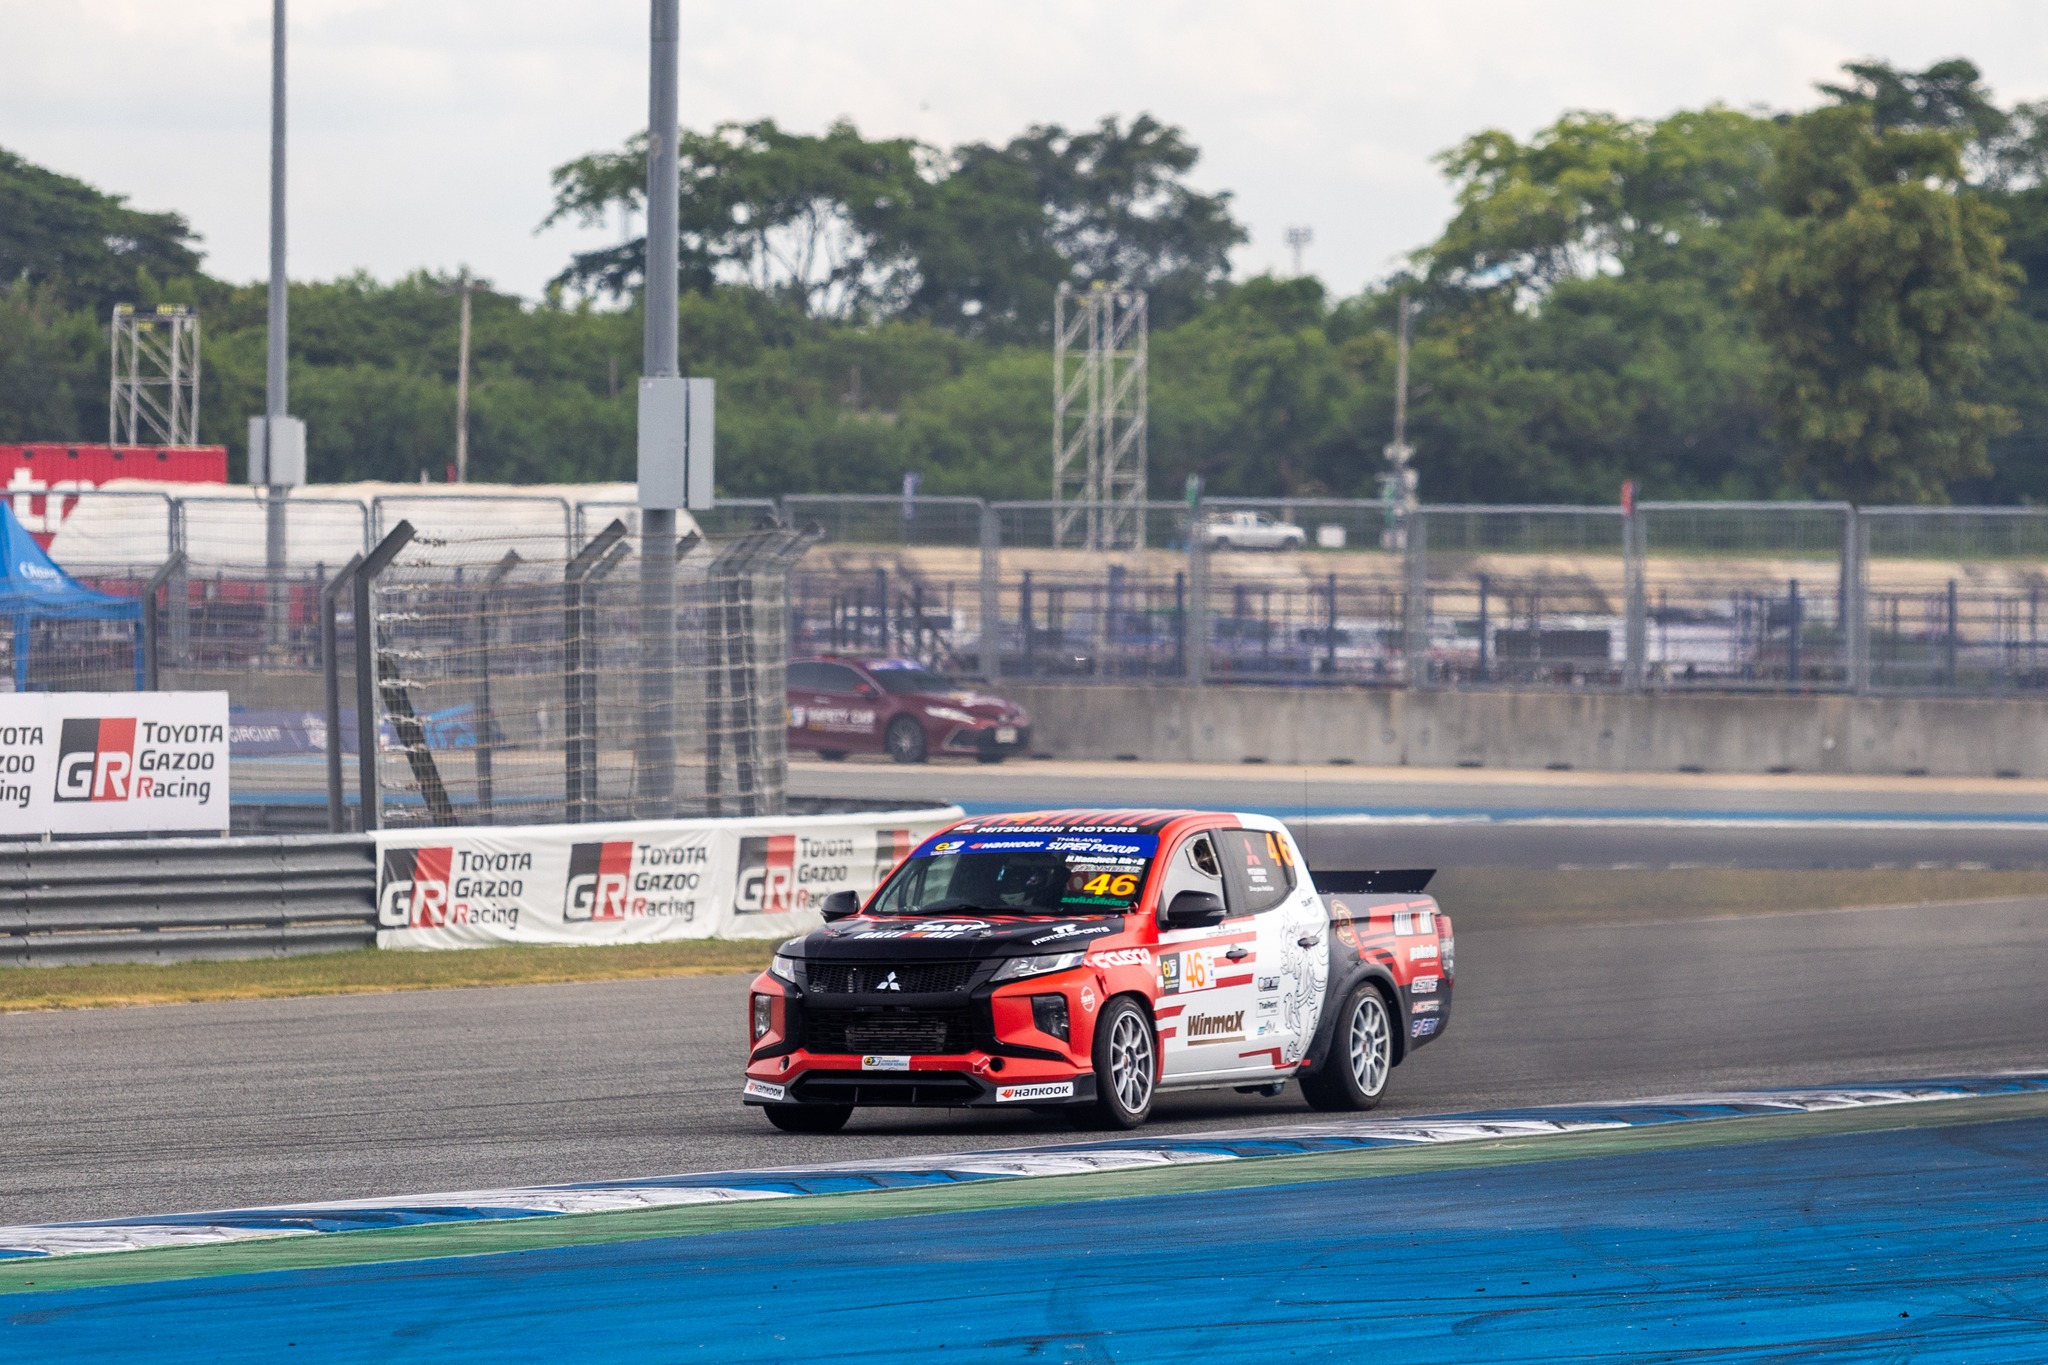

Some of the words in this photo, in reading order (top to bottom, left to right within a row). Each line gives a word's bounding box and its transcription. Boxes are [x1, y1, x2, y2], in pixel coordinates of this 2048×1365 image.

[143, 722, 223, 743] TOYOTA
[140, 749, 215, 770] GAZOO
[57, 751, 131, 798] GR
[136, 776, 211, 805] Racing
[638, 844, 706, 865] TOYOTA
[799, 838, 854, 858] TOYOTA
[1045, 842, 1092, 851] SUPER
[1089, 843, 1140, 854] PICKUP
[1265, 832, 1294, 867] 46
[458, 851, 532, 871] TOYOTA
[635, 872, 700, 891] GAZOO
[798, 864, 848, 882] GAZOO
[455, 878, 523, 898] GAZOO
[735, 866, 792, 911] GR
[1083, 874, 1138, 896] 46
[379, 880, 447, 926] GR
[566, 873, 627, 919] GR
[452, 903, 519, 929] Racing
[631, 897, 695, 922] Racing
[1031, 926, 1110, 946] MOTORSPORTS
[1186, 952, 1205, 988] 46
